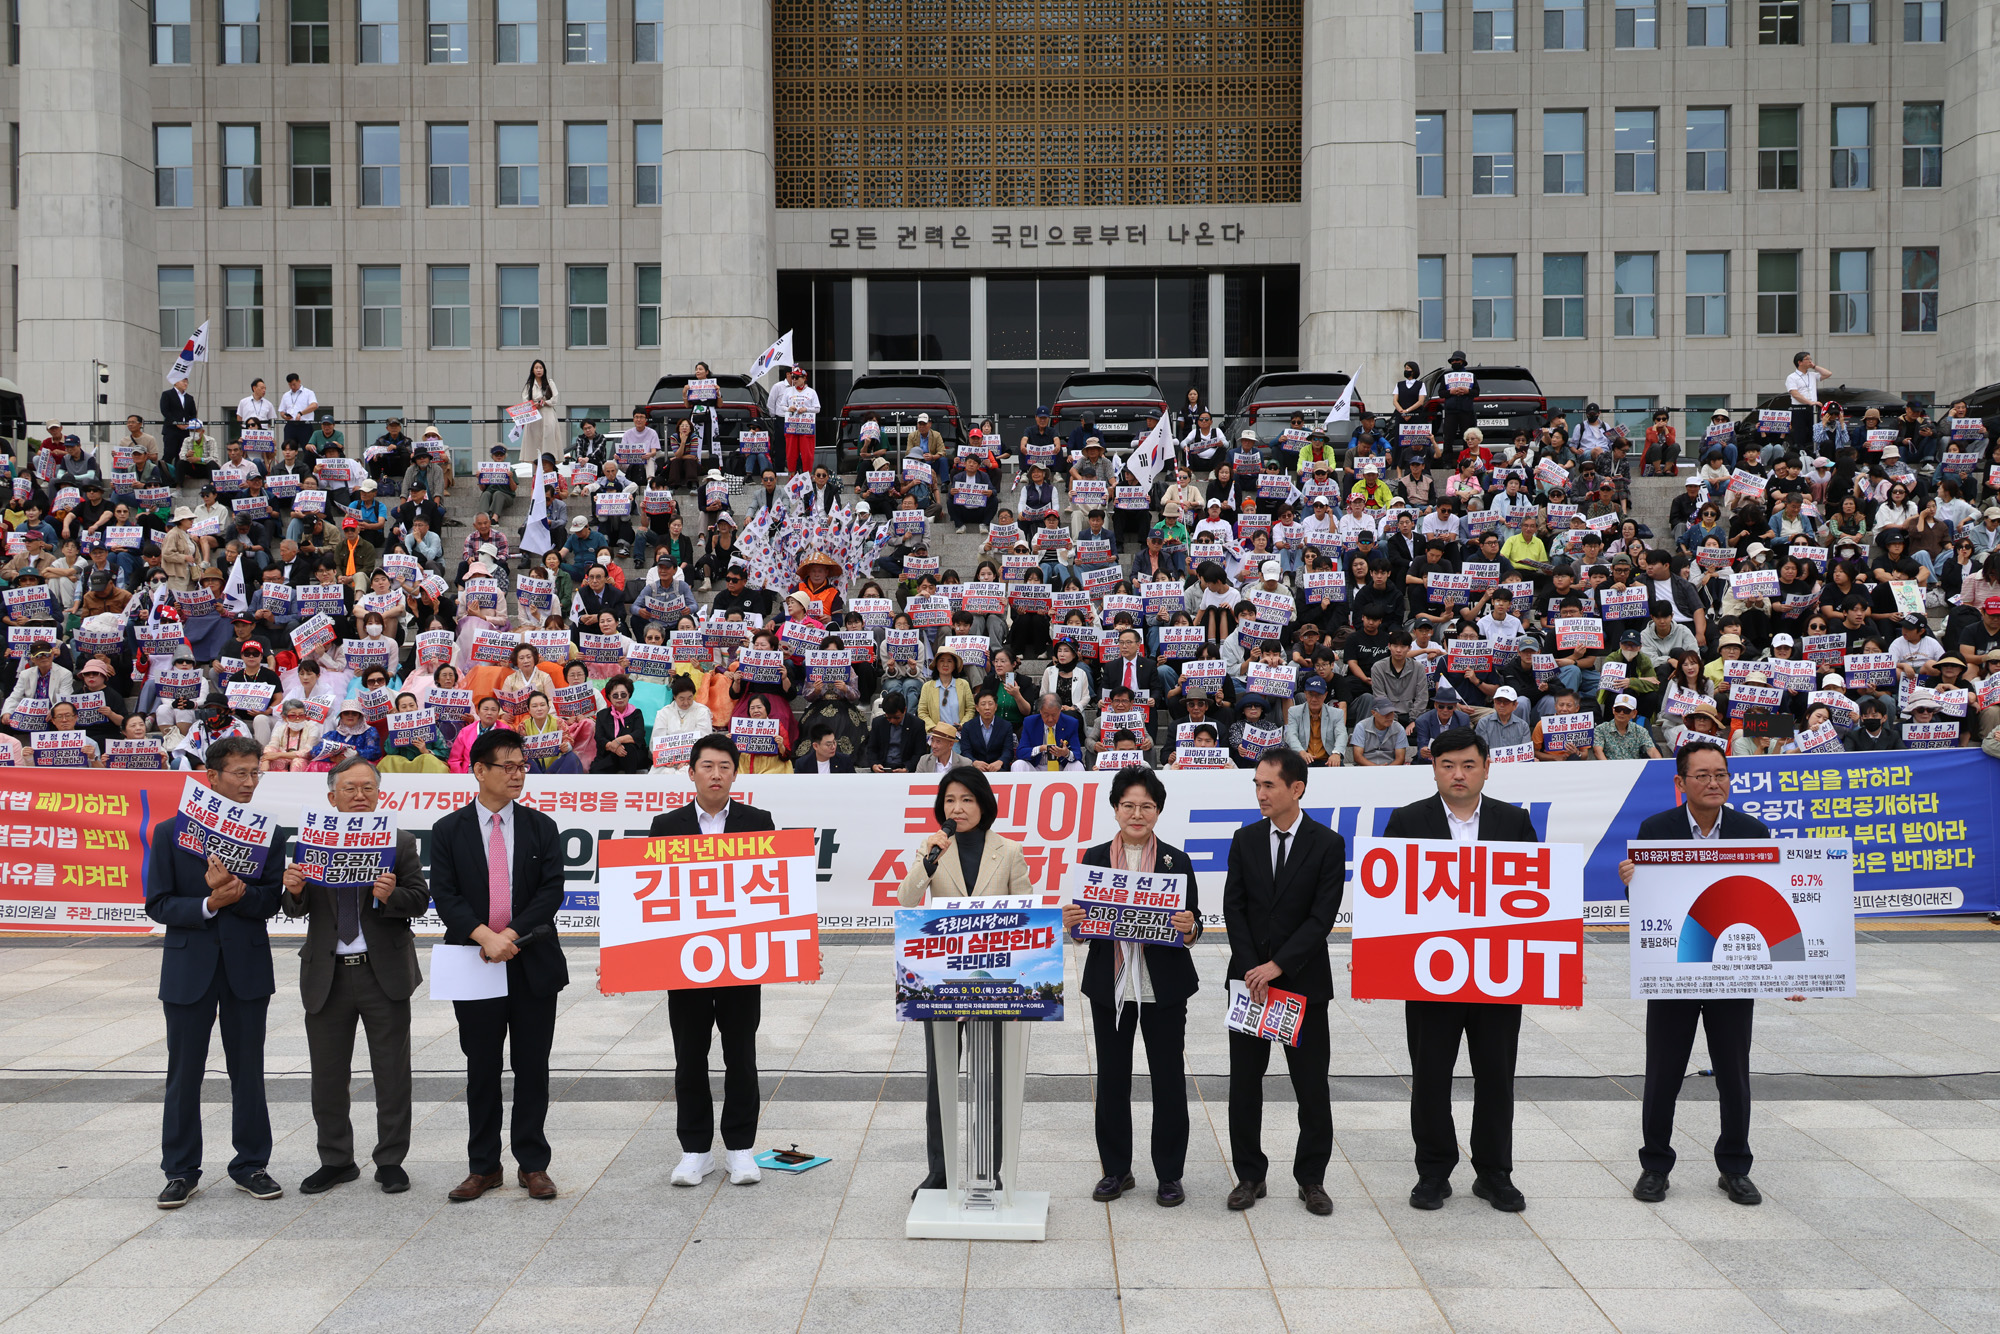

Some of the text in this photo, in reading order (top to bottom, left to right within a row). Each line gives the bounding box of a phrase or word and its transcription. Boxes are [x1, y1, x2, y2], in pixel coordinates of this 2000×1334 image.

[829, 222, 1245, 250] 모든 권력은 국민으로부터 나온다
[1777, 769, 1843, 792] 진실을
[1847, 765, 1913, 788] 밝혀라
[35, 792, 130, 816] 폐기하라
[1741, 793, 1940, 821] 유공자 전면공개하라
[185, 799, 267, 844] 진실을 밝혀라
[1854, 823, 1897, 845] 부터
[1902, 820, 1968, 843] 받아라
[83, 828, 130, 850] 반대
[178, 831, 205, 855] 전면
[187, 820, 253, 861] 518 유공자
[302, 827, 340, 847] 진실을
[343, 831, 392, 847] 밝혀라
[304, 848, 382, 868] 518 유공자
[644, 835, 777, 864] 새천년NHK
[1634, 851, 1650, 862] 5.18
[1650, 850, 1670, 862] 유공자
[1670, 851, 1684, 861] 명단
[1684, 850, 1698, 861] 공개
[1699, 850, 1719, 861] 필요성
[1786, 849, 1822, 860] 천지일보
[1852, 847, 1976, 874] 헌은 반대한다
[62, 864, 129, 888] 지켜라
[1360, 843, 1551, 919] 이재명
[1790, 874, 1823, 887] 69.7%
[633, 859, 790, 924] 김민석
[1083, 885, 1181, 908] 진실을 밝혀라
[1792, 892, 1822, 903] 필요하다
[1853, 892, 1953, 909] 원피살친형이래진
[935, 913, 1019, 935] 국회의사당에서
[1089, 905, 1170, 927] 518 유공자
[1640, 919, 1673, 932] 19.2%
[904, 926, 1057, 960] 국민이 심판한다
[1078, 919, 1179, 943] 전면 공개하라
[1640, 936, 1678, 948] 불필요하다
[680, 928, 811, 984] OUT
[946, 952, 1012, 971] 국민대회
[1413, 935, 1578, 999] OUT
[1277, 997, 1302, 1047] 대한다
